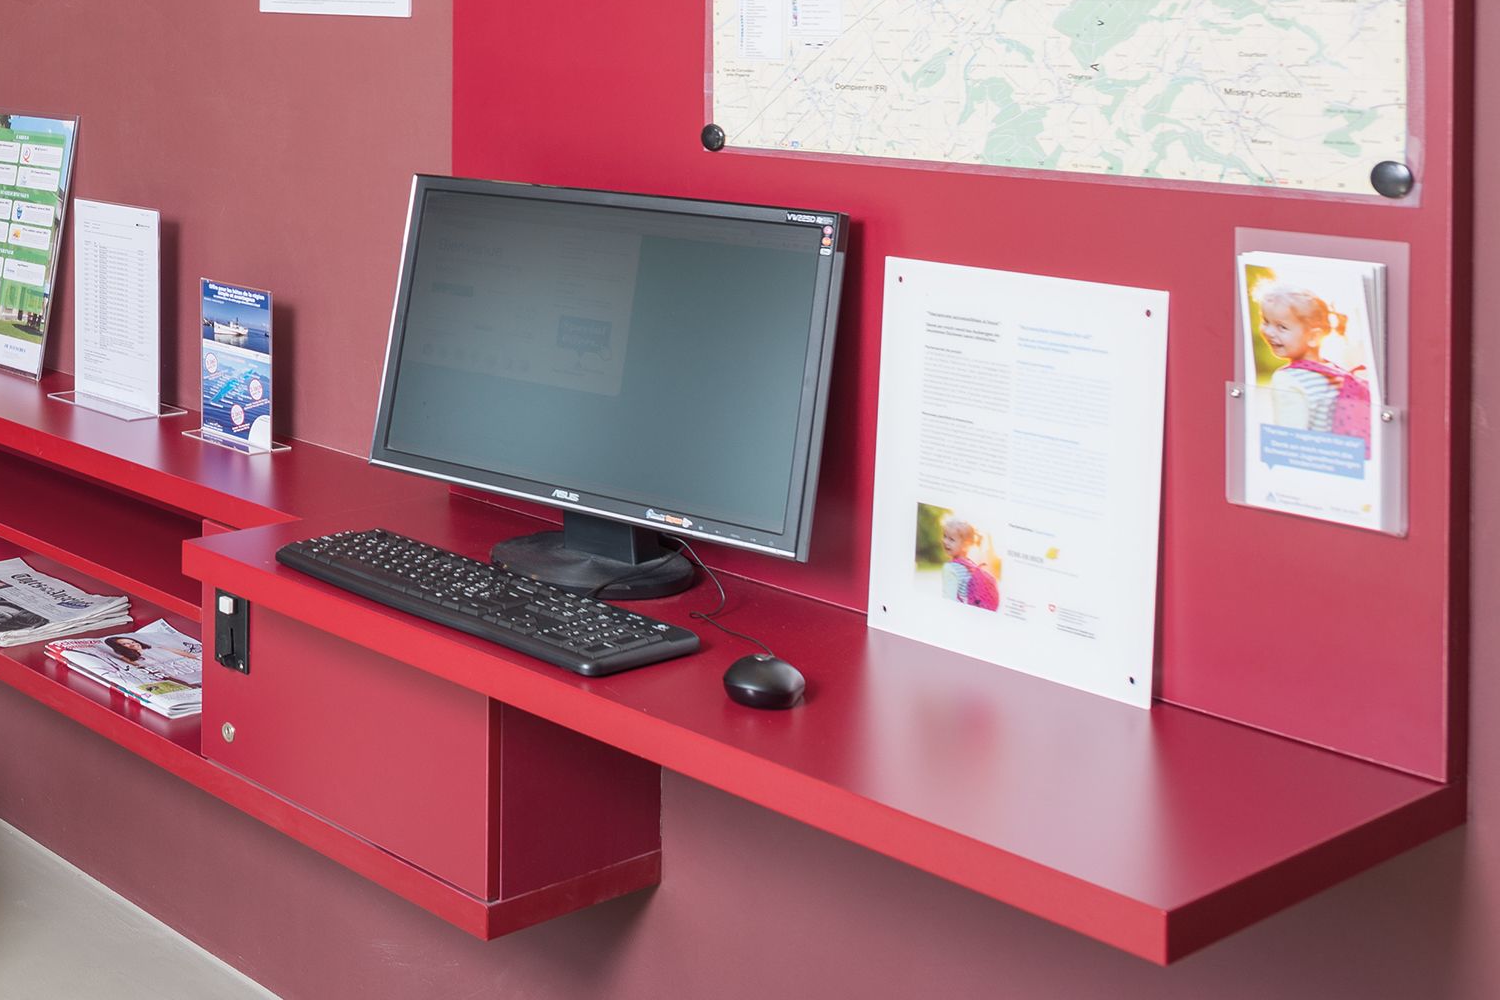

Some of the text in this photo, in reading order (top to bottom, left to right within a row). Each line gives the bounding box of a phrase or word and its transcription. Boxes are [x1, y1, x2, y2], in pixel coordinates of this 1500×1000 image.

[834, 83, 873, 92] Dompierre
[1224, 87, 1302, 98] Misery-Courtion
[551, 489, 580, 502] ASUS
